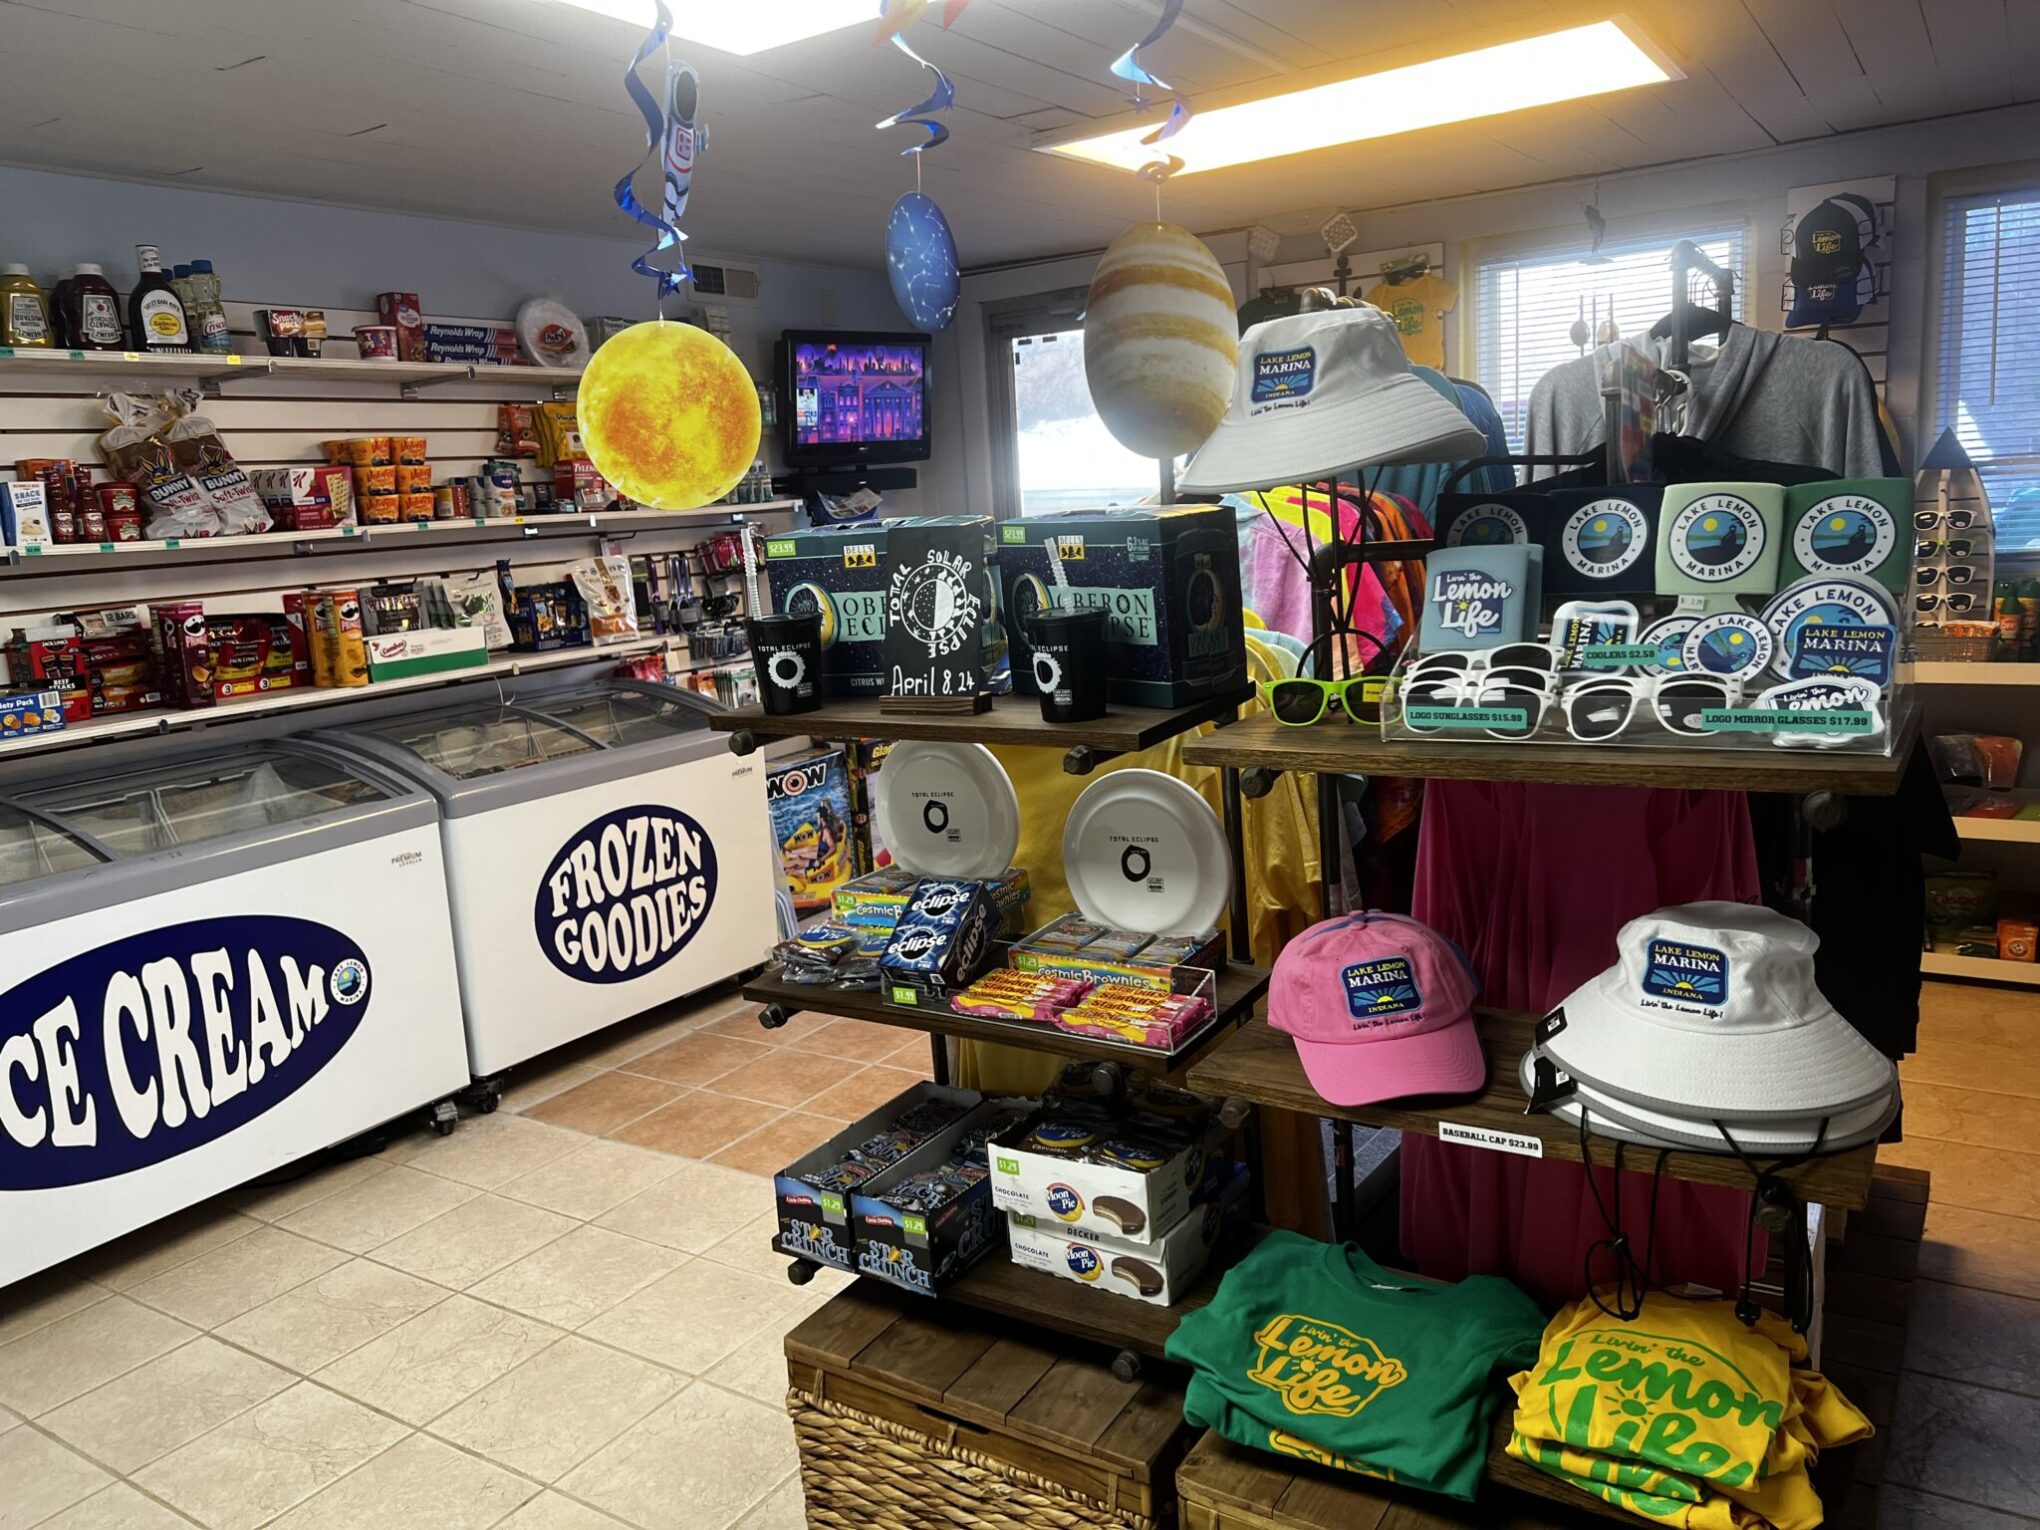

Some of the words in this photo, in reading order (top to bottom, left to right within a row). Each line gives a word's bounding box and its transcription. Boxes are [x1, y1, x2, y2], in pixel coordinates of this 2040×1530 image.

[272, 312, 300, 325] Snack
[430, 326, 464, 338] Reynolds
[464, 327, 484, 340] Wrap
[430, 342, 464, 354] Reynolds
[464, 345, 486, 357] Wrap
[1260, 356, 1284, 364] LAKE
[1286, 350, 1311, 362] LEMON
[1259, 360, 1311, 375] MARINA
[206, 470, 244, 490] BUNNY
[15, 490, 40, 500] SNACK
[151, 479, 189, 500] BUNNY
[1454, 508, 1482, 534] LAKE
[1490, 506, 1523, 536] LEMON
[1570, 505, 1599, 530] LAKE
[1607, 502, 1642, 528] LEMON
[1678, 502, 1708, 530] LAKE
[1717, 500, 1758, 529] LEMON
[1802, 502, 1835, 530] LAKE
[1846, 500, 1889, 528] LEMON
[1004, 530, 1024, 540] $23.99
[769, 543, 794, 554] $23.99
[927, 550, 972, 579] SOLAR
[1576, 558, 1629, 574] MARINA
[1686, 560, 1744, 576] MARINA
[890, 563, 912, 628] TOTAL
[1434, 575, 1512, 602] Lemon
[114, 610, 136, 620] BARS
[1440, 599, 1499, 638] Life
[1770, 598, 1805, 636] LAKE
[1815, 589, 1878, 616] LEMON
[928, 593, 981, 658] ECLIPSE
[1569, 616, 1580, 646] LEMON
[1804, 628, 1839, 638] LAKE
[1843, 629, 1886, 639] LEMON
[782, 642, 812, 652] ECLIPSE
[1038, 644, 1068, 652] ECLIPSE
[1718, 618, 1754, 630] LAKE
[1752, 629, 1768, 669] LEMON
[1804, 638, 1882, 653] MARINA
[1586, 651, 1627, 659] COOLERS
[1629, 650, 1654, 658] $2.59
[54, 678, 69, 686] BEEF
[891, 664, 936, 696] April
[958, 670, 976, 692] 24
[16, 698, 34, 706] Pack
[1784, 692, 1808, 702] Livin'
[1410, 711, 1431, 720] LOGO
[1433, 712, 1490, 721] SUNGLASSES
[1492, 714, 1522, 722] $15.99
[1706, 714, 1732, 724] LOGO
[1734, 715, 1775, 724] MIRROR
[1777, 716, 1828, 726] GLASSES
[1829, 716, 1868, 726] $17.99
[767, 763, 826, 800] WOW
[391, 852, 422, 864] PREMIUM
[549, 816, 702, 918] FROZEN
[912, 890, 970, 911] eclipse
[554, 875, 707, 972] GOODIES
[888, 934, 947, 954] eclipse
[956, 903, 987, 982] eclipse
[1654, 944, 1682, 956] LAKE
[1686, 949, 1720, 961] LEMON
[333, 964, 344, 982] LAKE
[346, 960, 364, 973] LEMON
[1347, 966, 1374, 976] LAKE
[1376, 962, 1406, 972] LEMON
[1654, 954, 1720, 972] MARINA
[1348, 970, 1408, 988] MARINA
[340, 990, 363, 1002] MARINA
[1663, 988, 1704, 1000] INDIANA
[1368, 1002, 1405, 1013] INDIANA
[1676, 1004, 1702, 1014] Lemon
[103, 947, 330, 1142] CREAM
[1442, 1128, 1488, 1142] BASEBALL
[1488, 1136, 1507, 1145] CAP
[1509, 1140, 1539, 1150] $23.99
[998, 1160, 1018, 1172] $1.29
[994, 1186, 1030, 1200] CHOCOLATE
[824, 1197, 841, 1210] $1.29
[1062, 1198, 1076, 1210] Pie
[904, 1218, 923, 1231] $1.29
[1067, 1227, 1100, 1242] DECKER
[781, 1232, 850, 1266] CRUNCH
[1014, 1242, 1050, 1258] CHOCOLATE
[858, 1253, 931, 1288] CRUNCH
[1081, 1258, 1096, 1268] Pie
[1298, 1324, 1337, 1343] Livin'
[1338, 1338, 1360, 1348] the
[1260, 1316, 1403, 1386] Lemon
[1590, 1333, 1658, 1355] Livin'
[1665, 1346, 1706, 1368] the
[1252, 1356, 1362, 1409] Life
[1538, 1340, 1785, 1433] Lemon
[1564, 1383, 1755, 1488] Life
